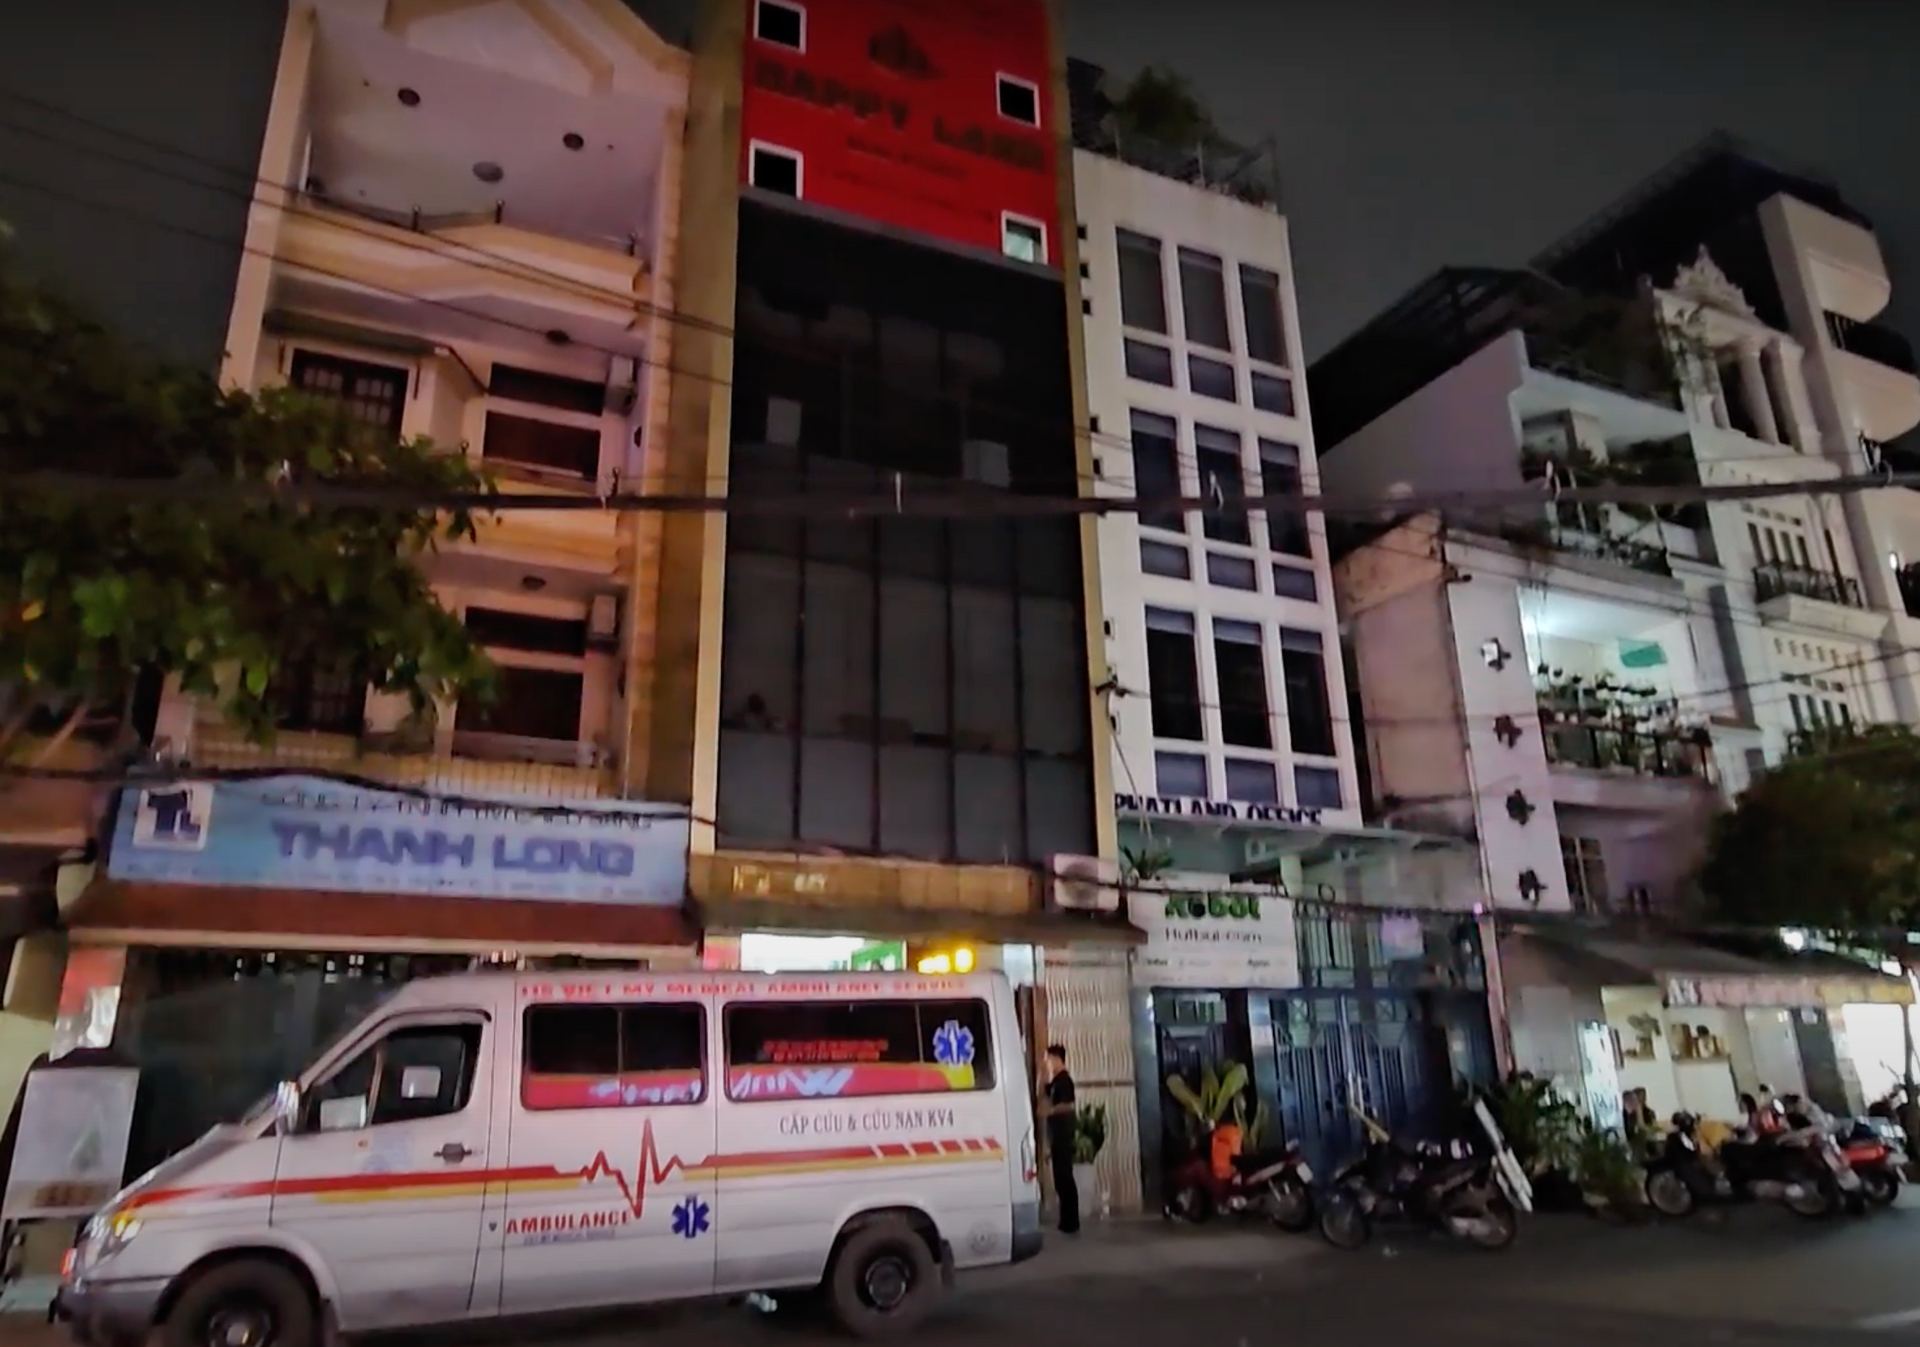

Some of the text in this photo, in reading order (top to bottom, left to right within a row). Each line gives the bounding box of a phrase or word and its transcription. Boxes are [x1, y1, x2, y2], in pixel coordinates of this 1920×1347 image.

[755, 56, 909, 132] HAPPY
[269, 820, 635, 877] THANH LONG
[666, 981, 755, 995] MEDICAL
[767, 979, 881, 994] AMBULANCE
[892, 977, 965, 993] SERVICE
[780, 1108, 808, 1135] CẤP
[849, 1114, 857, 1132] &
[506, 1209, 629, 1235] AMBULANCE
